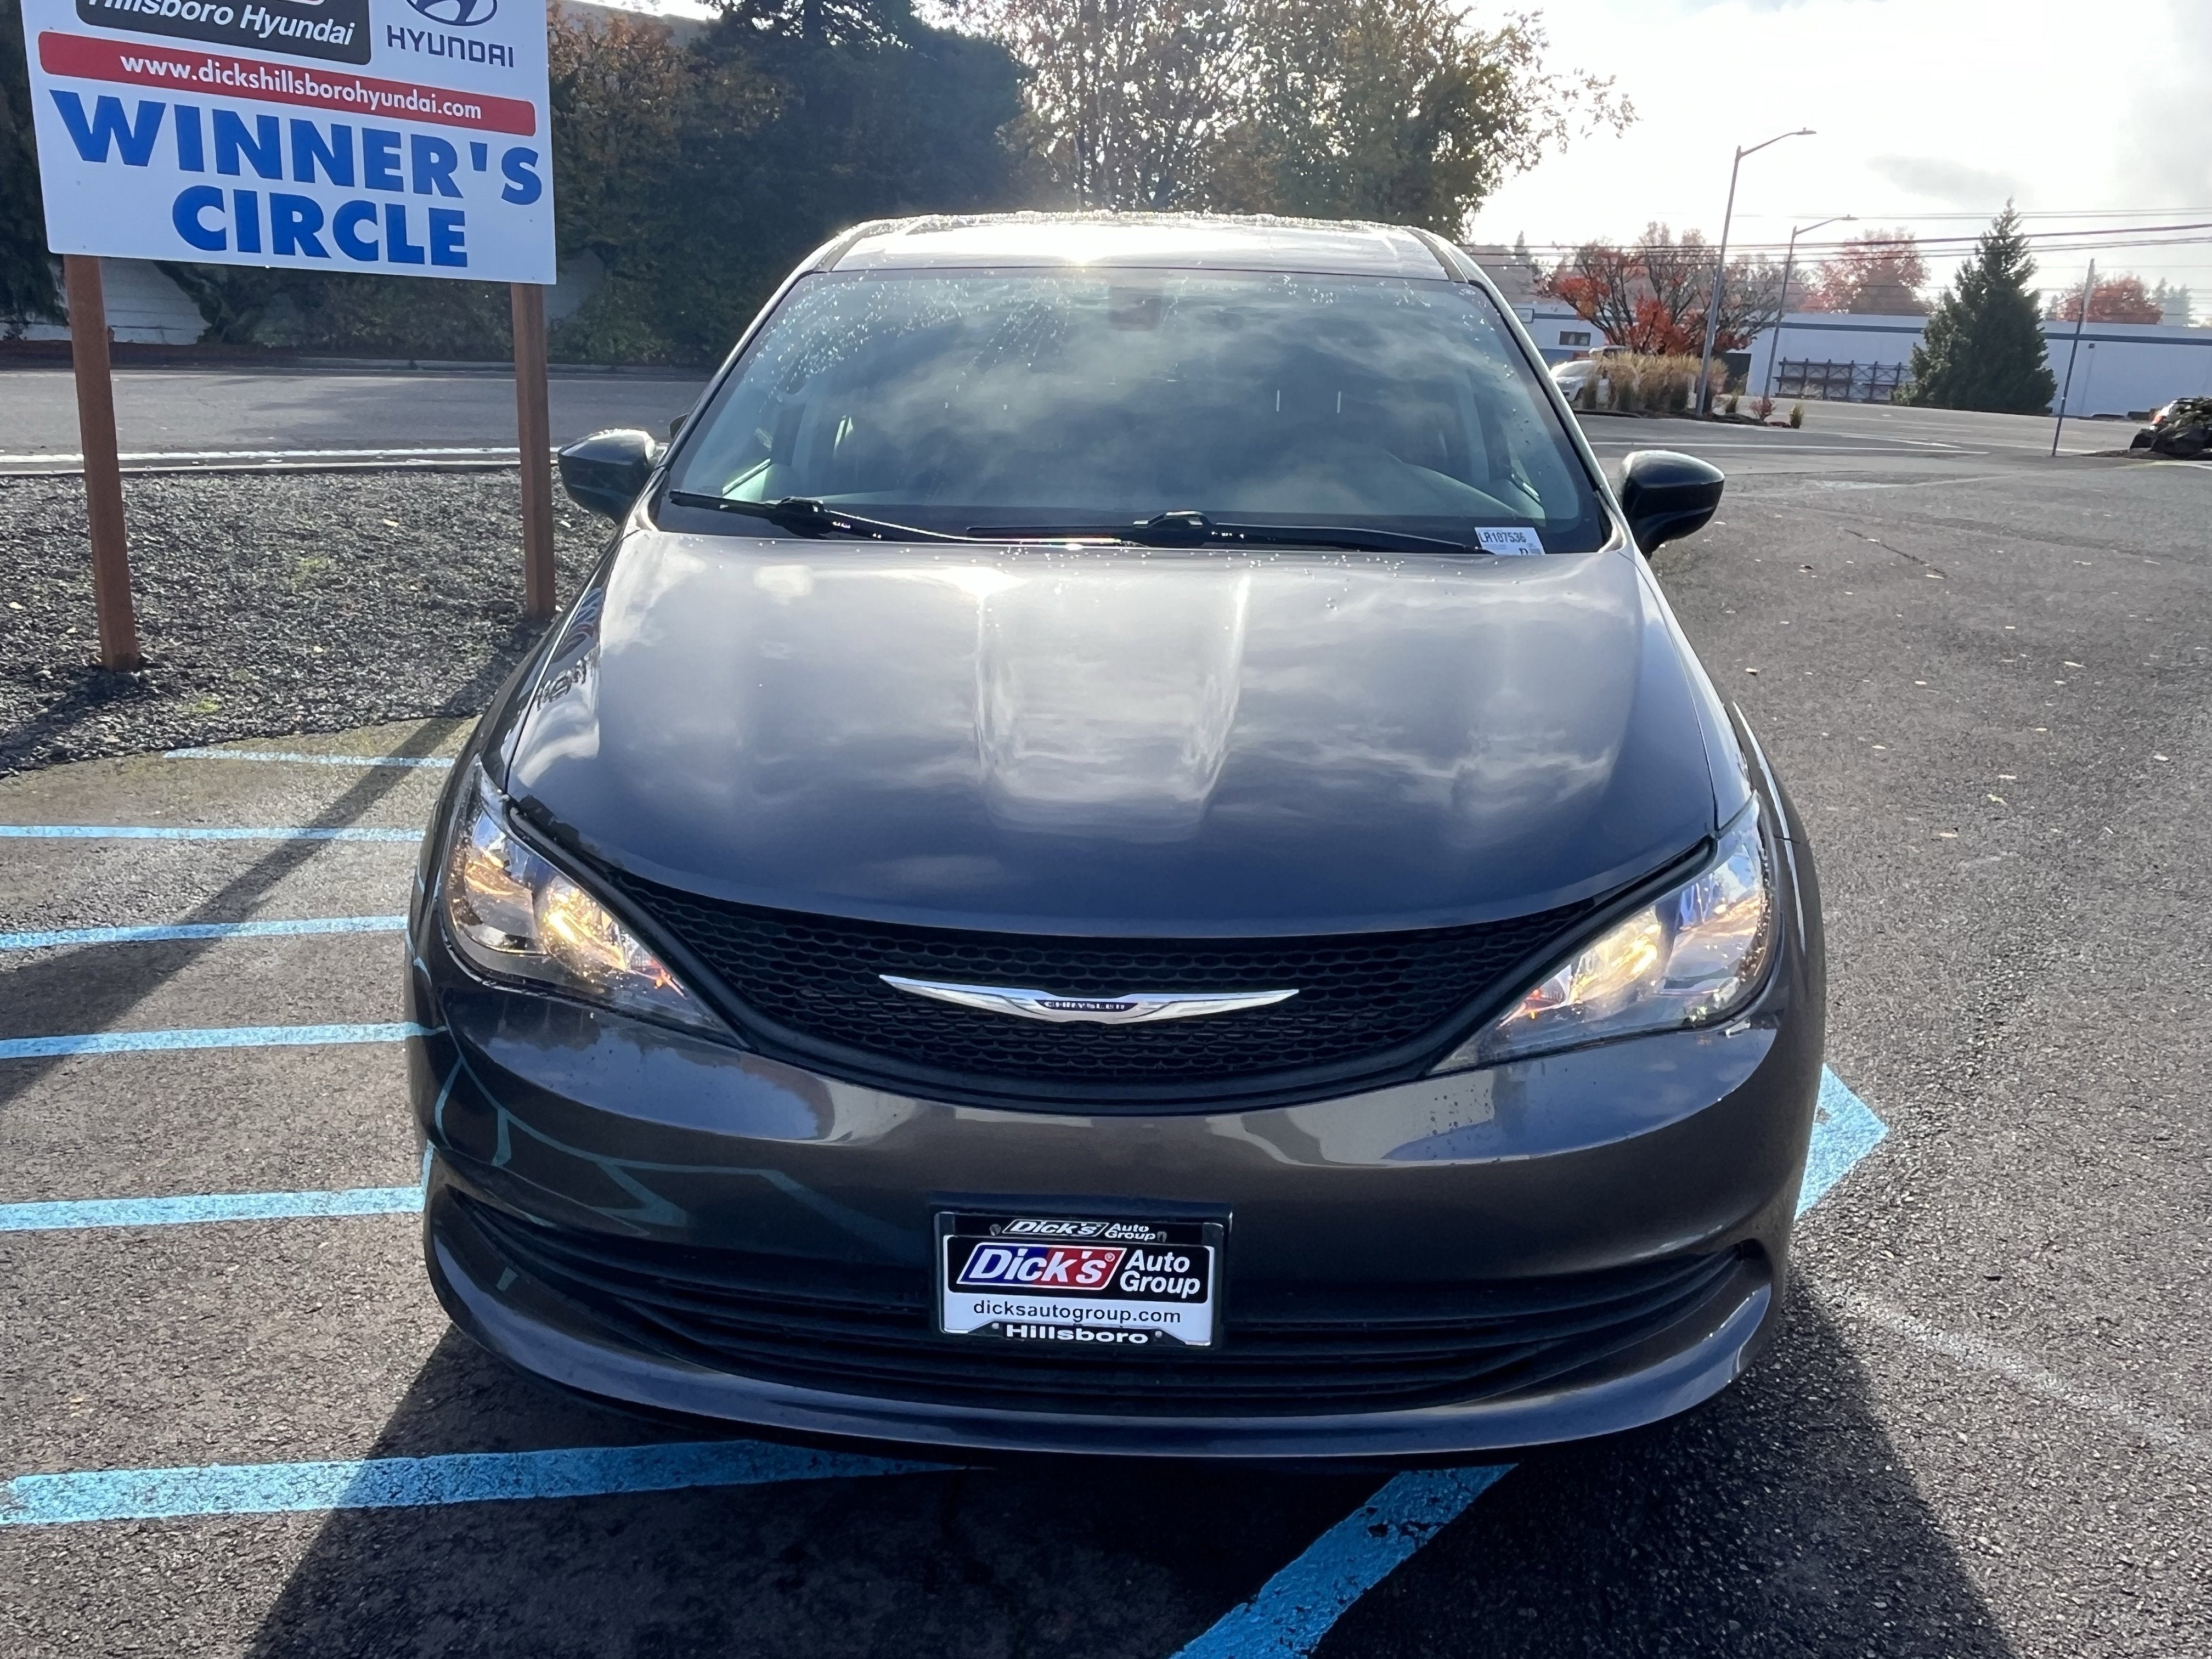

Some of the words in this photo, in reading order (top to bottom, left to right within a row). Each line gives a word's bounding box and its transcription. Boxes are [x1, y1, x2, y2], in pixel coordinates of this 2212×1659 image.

[240, 7, 355, 45] Hyundai
[386, 26, 514, 69] HYUNDAI
[120, 55, 482, 120] www.dickshillsborohyundai.com
[49, 89, 542, 205] WINNER'S
[172, 185, 468, 267] CIRCLE
[1104, 1231, 1156, 1241] Group
[1109, 1223, 1149, 1232] Auto
[1125, 1249, 1190, 1273] Auto
[1120, 1271, 1201, 1299] Group
[973, 1300, 1181, 1323] dicksautogroup.com
[1006, 1324, 1148, 1344] Hillsboro
